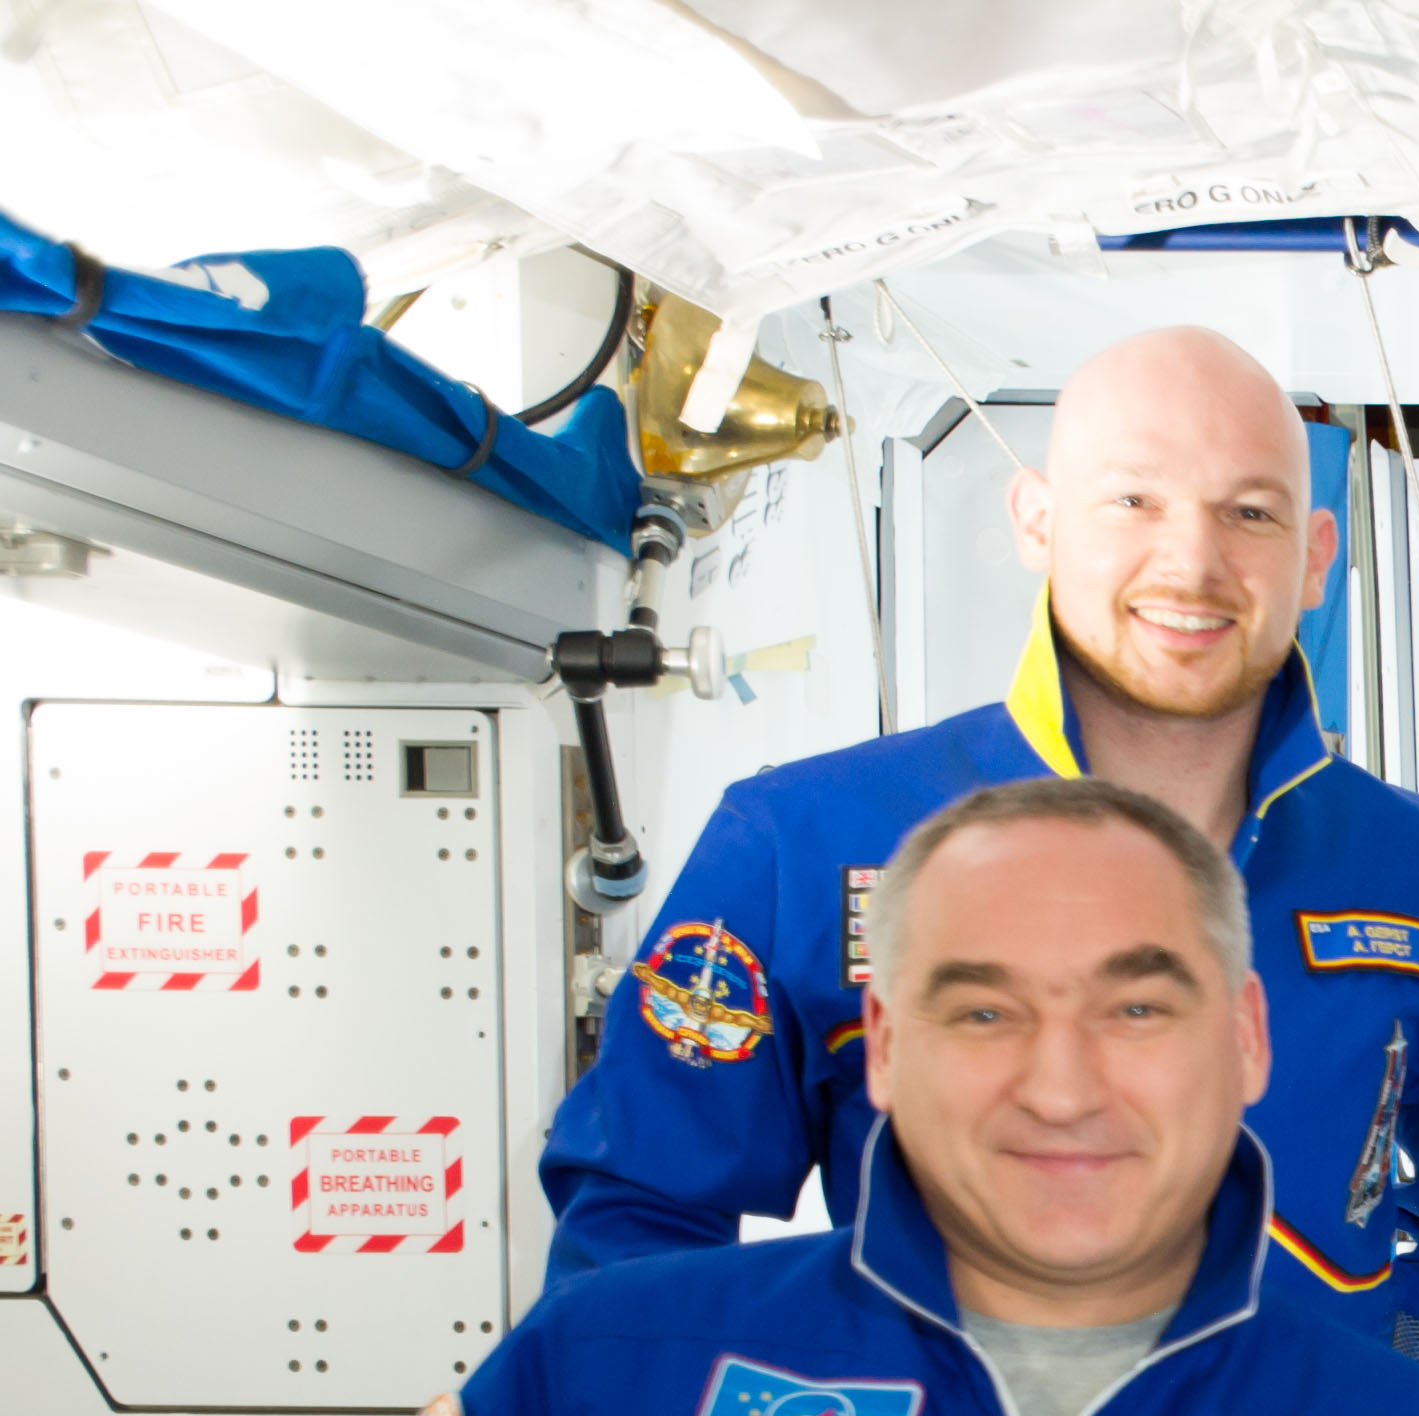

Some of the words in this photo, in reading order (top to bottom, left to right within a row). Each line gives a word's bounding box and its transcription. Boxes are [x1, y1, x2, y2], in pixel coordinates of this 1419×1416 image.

[1208, 184, 1232, 203] G
[113, 881, 228, 897] PORTABLE
[137, 912, 206, 933] FIRE
[106, 947, 238, 962] EXTINGUISHER
[331, 1148, 422, 1163] PORTABLE
[320, 1175, 434, 1193] BREATHING
[328, 1202, 429, 1217] APPARATUS
